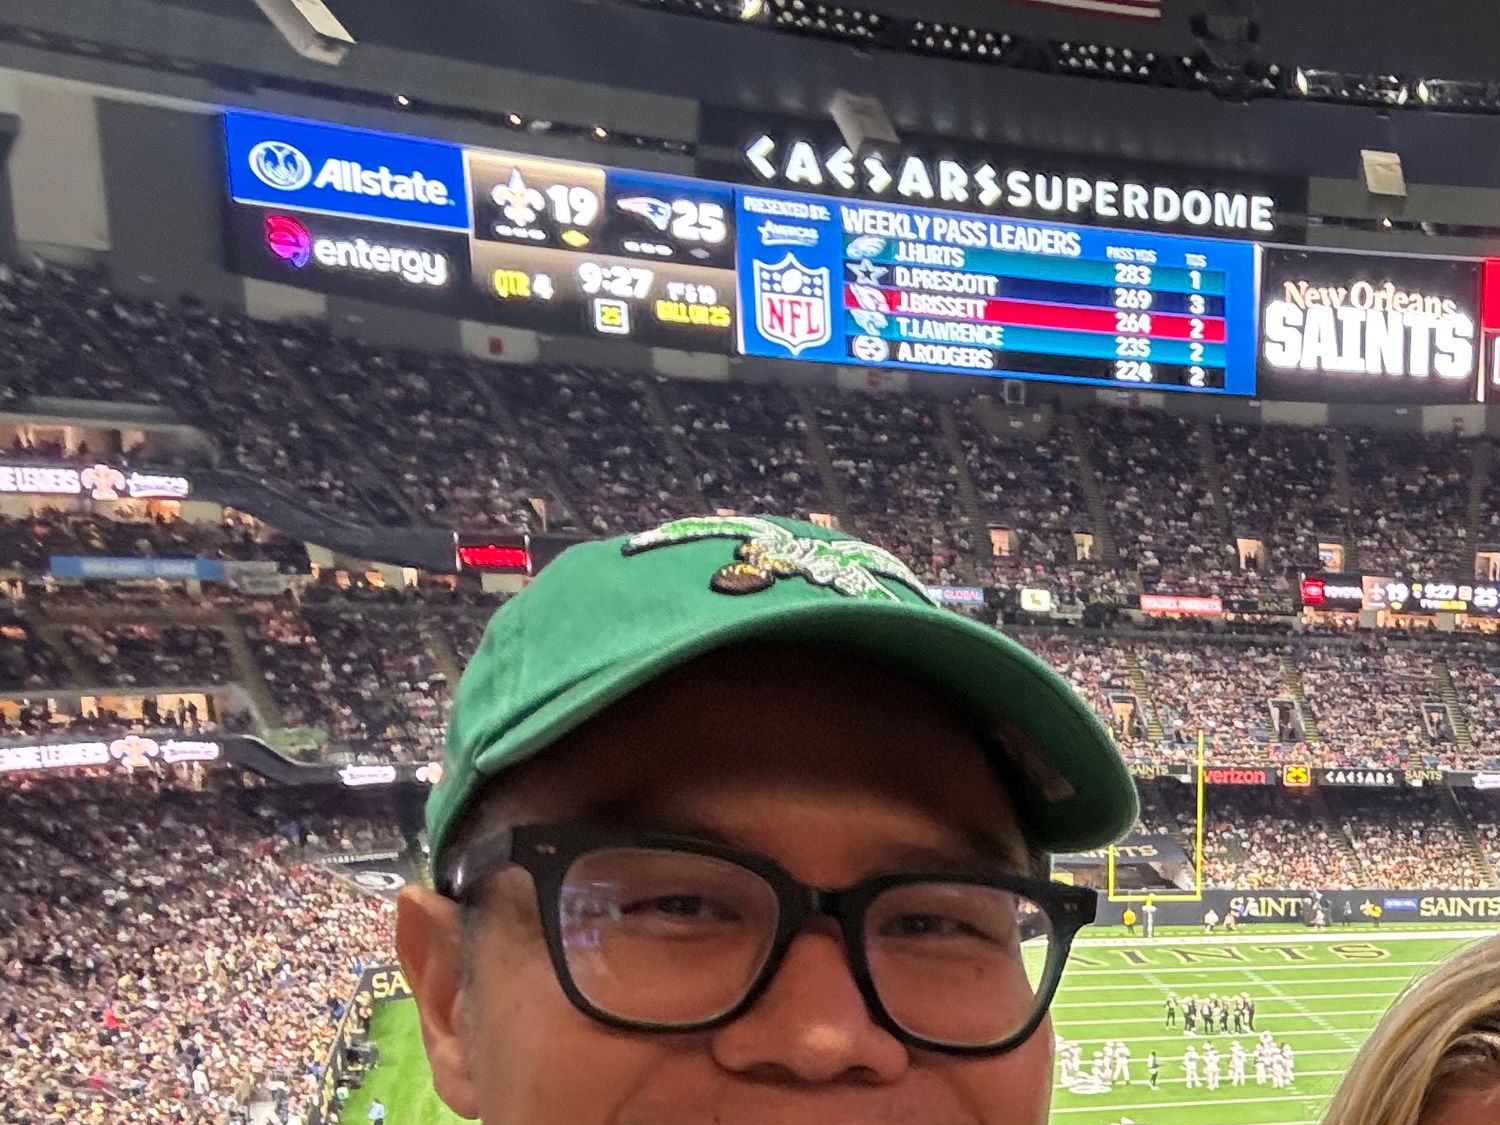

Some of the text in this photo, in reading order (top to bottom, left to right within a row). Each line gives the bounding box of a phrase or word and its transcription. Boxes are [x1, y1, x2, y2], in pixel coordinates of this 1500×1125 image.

[316, 158, 448, 202] Allstate
[745, 135, 1275, 232] CAESARS SUPERDOME
[547, 184, 598, 226] 19
[669, 201, 727, 243] 25
[840, 205, 1081, 257] WEEKLY PASS LEADERS
[315, 237, 447, 287] entergy
[895, 241, 966, 267] J.HURTS
[533, 273, 554, 299] 4
[578, 262, 654, 299] 9:27
[895, 265, 999, 296] D.PRESCOTT
[1115, 263, 1152, 285] 283
[1189, 270, 1201, 290] 1
[896, 290, 988, 320] J.BRISSETT
[1115, 288, 1152, 310] 269
[1189, 294, 1205, 315] 3
[1284, 280, 1456, 320] New Orleans
[767, 297, 822, 335] NFL
[1114, 312, 1152, 334] 264
[1189, 318, 1204, 339] 2
[896, 316, 1005, 346] T.LAWRENCE
[1265, 300, 1474, 379] SAINTS
[897, 341, 994, 370] A.RODGERS
[1115, 336, 1151, 358] 235
[1189, 342, 1204, 362] 2
[1115, 360, 1153, 383] 224
[1189, 366, 1205, 387] 2
[1202, 768, 1266, 784] verizon
[1324, 770, 1395, 784] CAESARS
[1405, 769, 1443, 782] SAINTS
